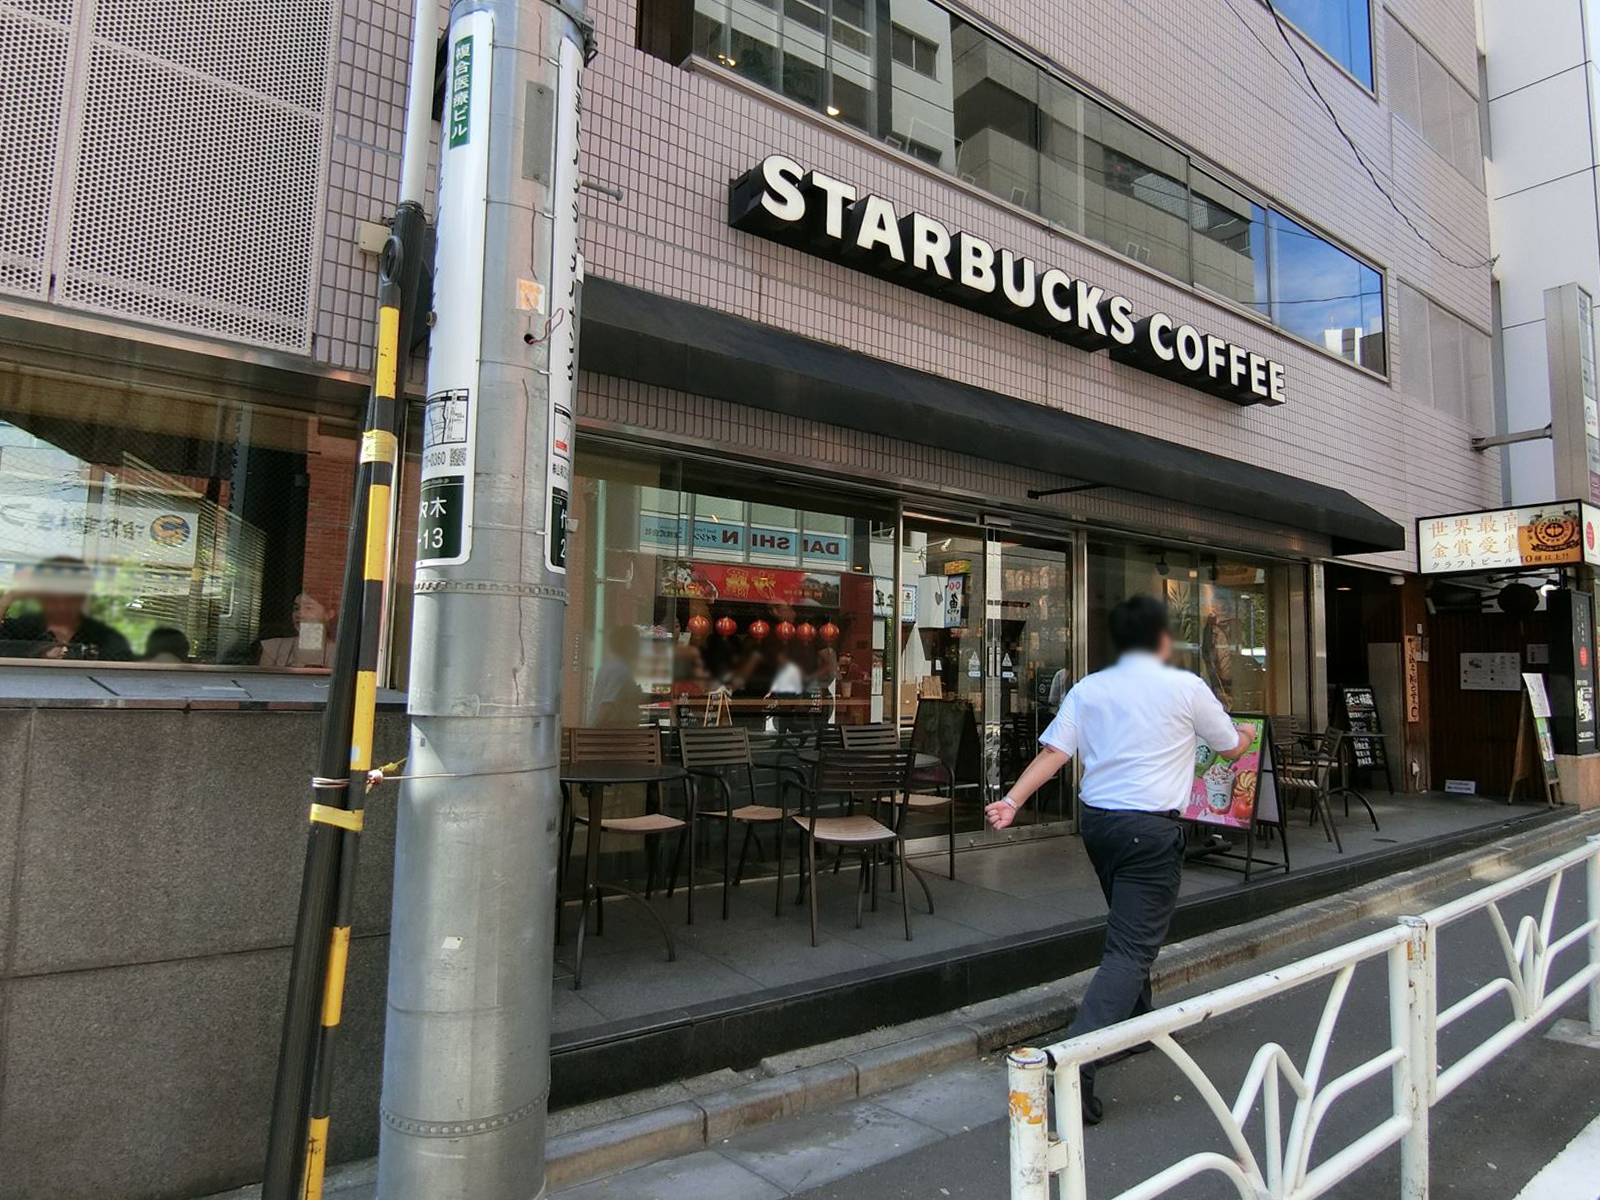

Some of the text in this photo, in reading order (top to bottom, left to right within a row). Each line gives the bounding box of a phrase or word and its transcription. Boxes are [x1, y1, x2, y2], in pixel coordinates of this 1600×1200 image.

[451, 42, 471, 139] 複合医療ビル
[760, 154, 1286, 404] STARBUCKS COFFEE
[1432, 557, 1515, 570] クラフトビール
